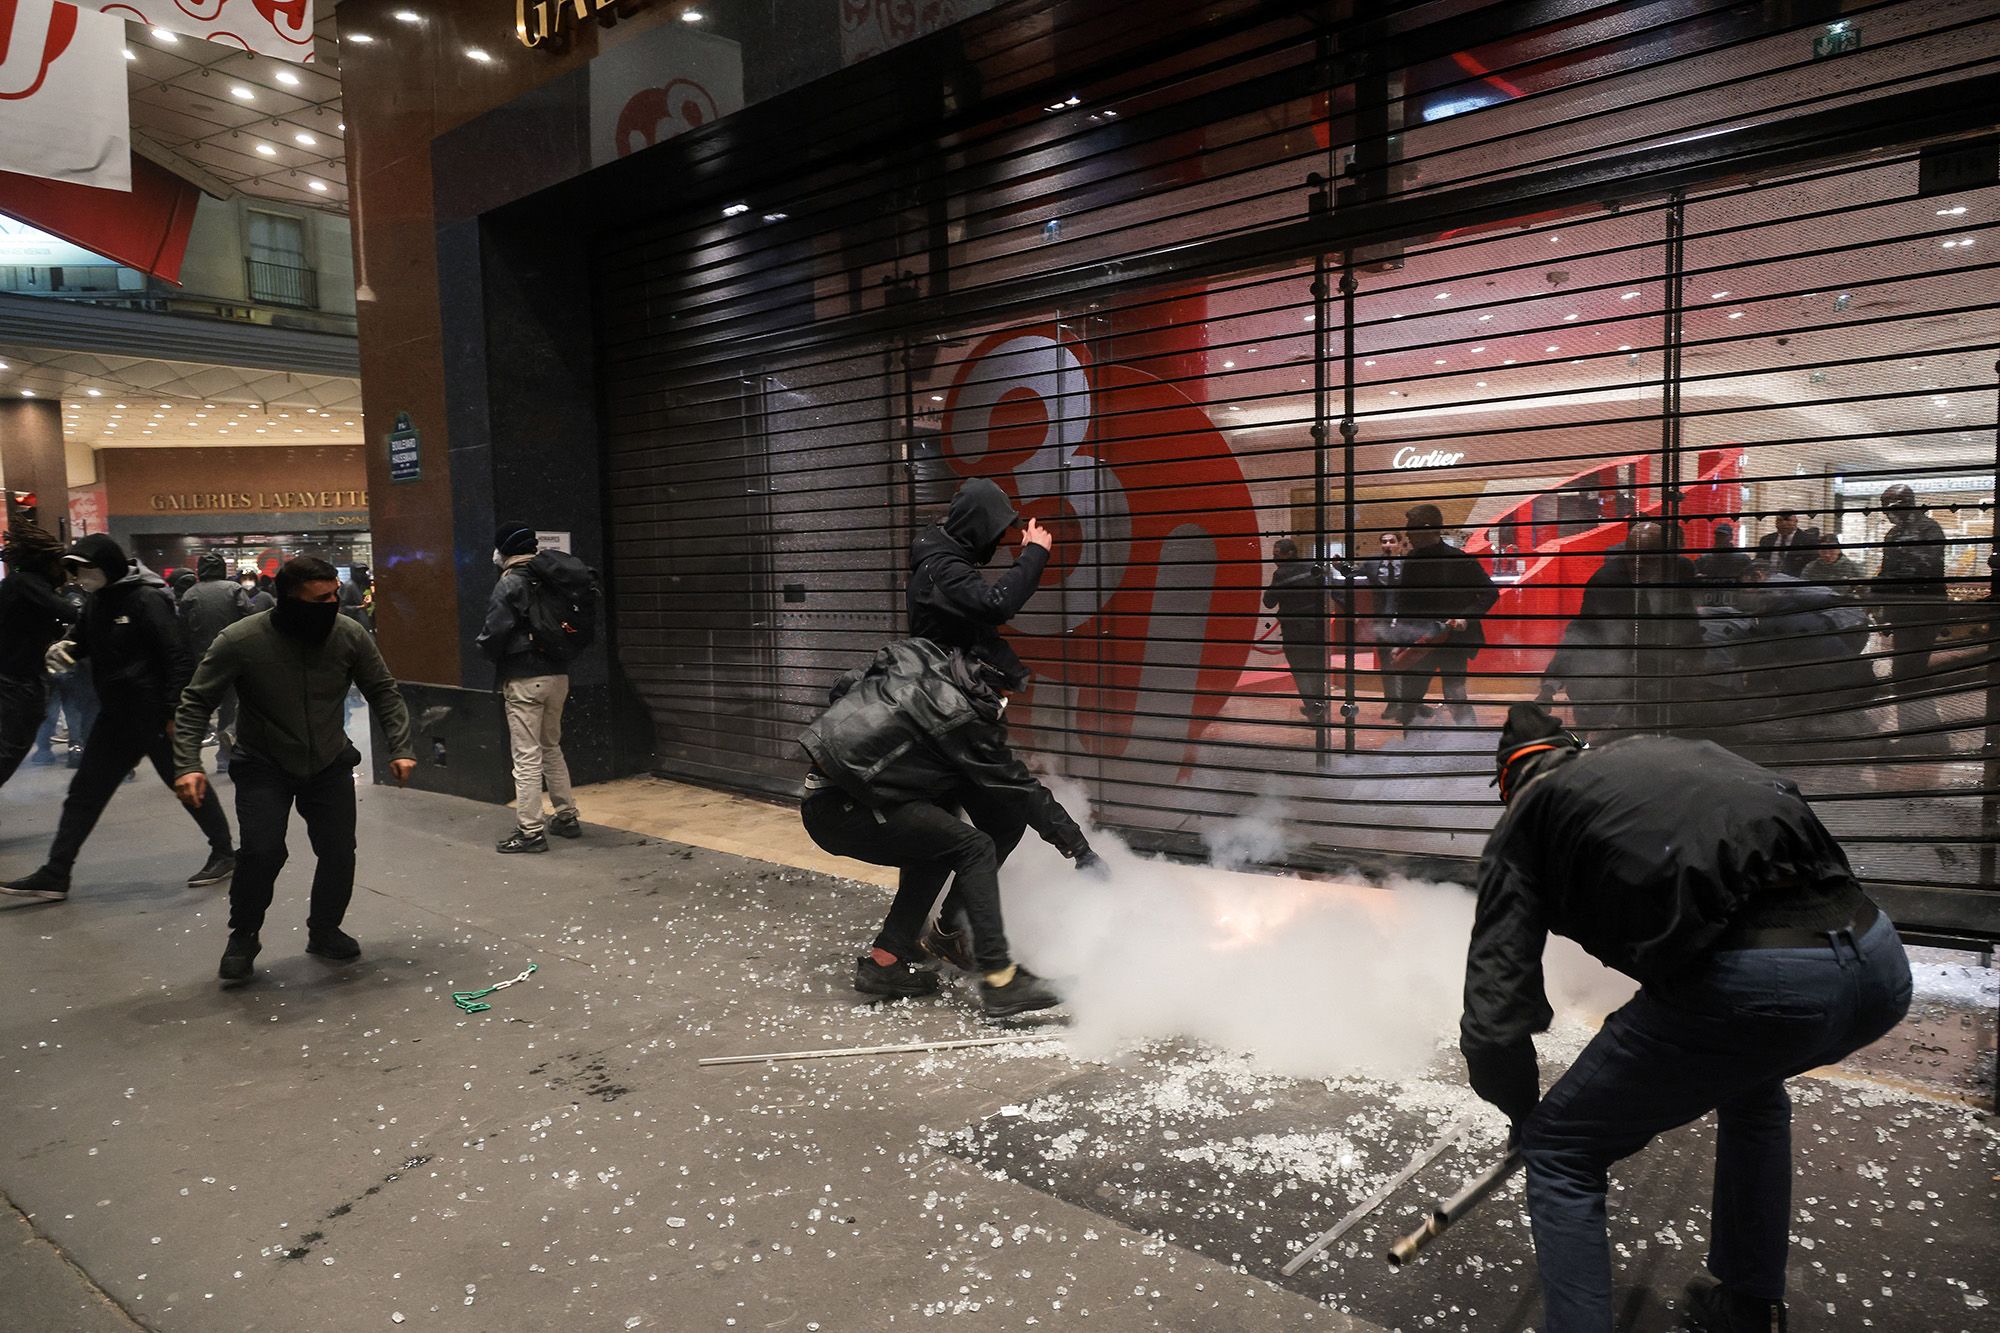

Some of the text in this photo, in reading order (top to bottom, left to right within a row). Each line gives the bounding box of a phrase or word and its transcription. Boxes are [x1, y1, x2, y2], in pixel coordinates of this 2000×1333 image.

[1392, 446, 1465, 469] Cartier
[151, 491, 369, 510] GALERIES LAFAYETTE
